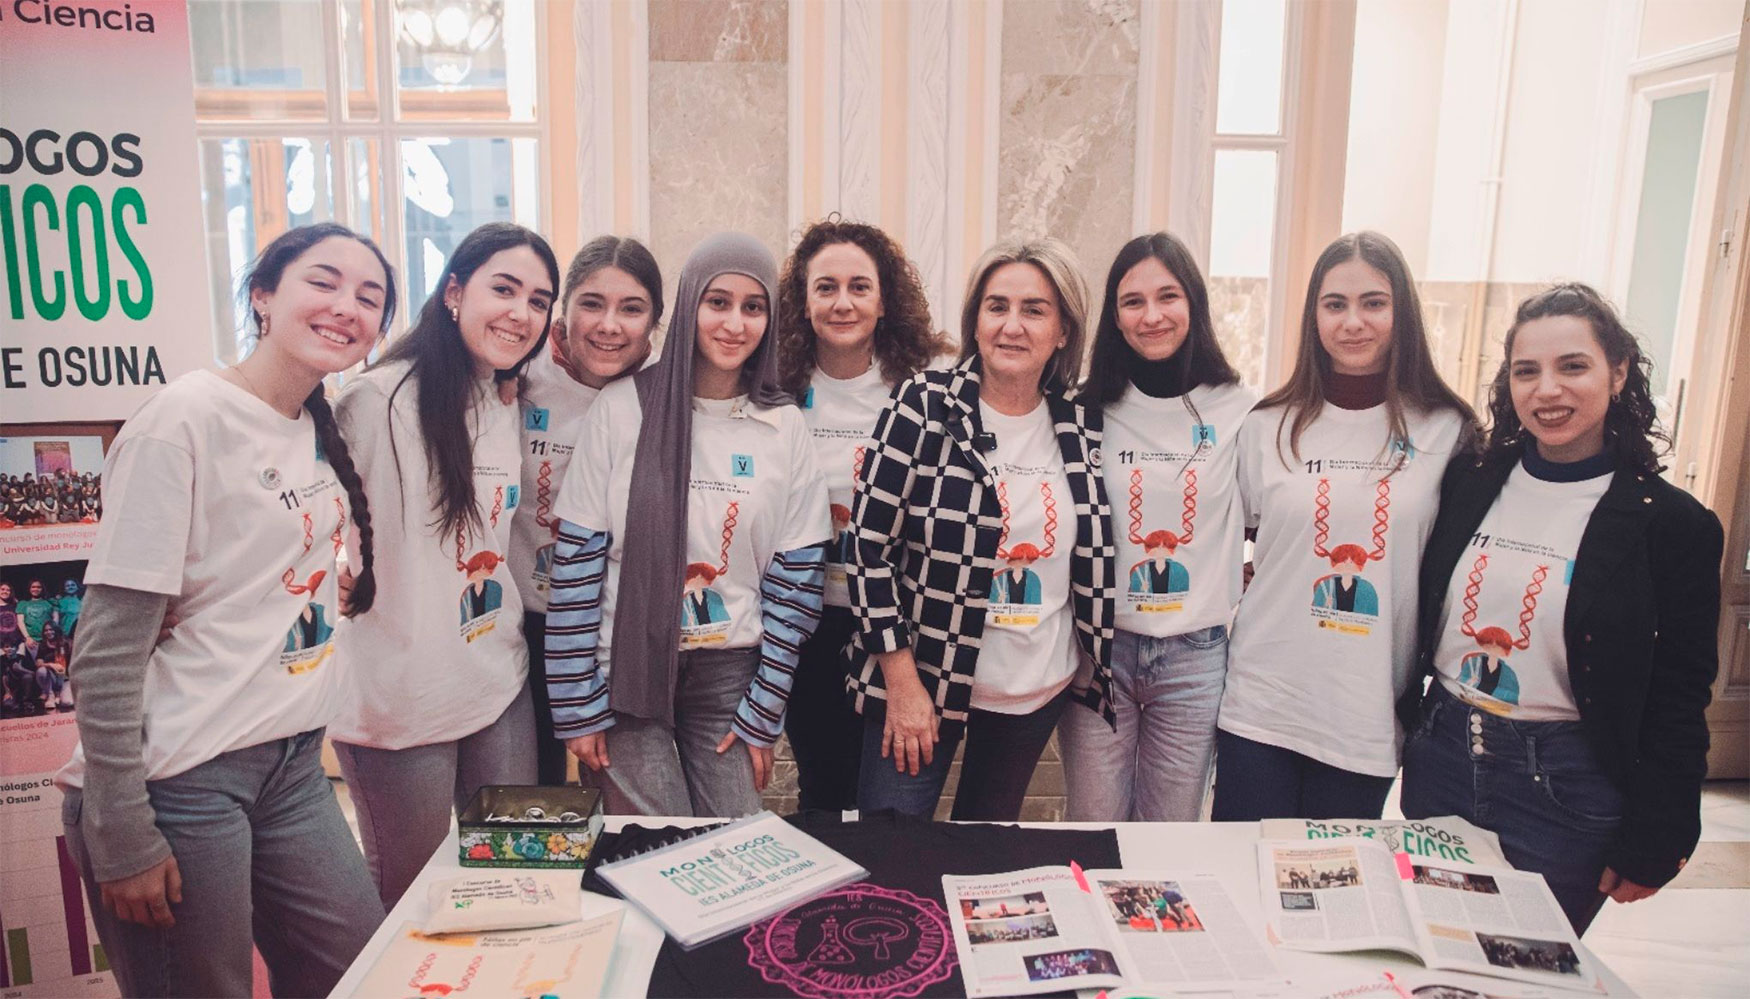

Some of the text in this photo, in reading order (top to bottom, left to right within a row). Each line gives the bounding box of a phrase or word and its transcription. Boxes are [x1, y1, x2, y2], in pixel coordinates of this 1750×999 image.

[14, 0, 155, 33] Ciencia
[0, 183, 154, 321] ICOS
[38, 346, 166, 388] OSUNA
[530, 440, 546, 455] 11
[1118, 450, 1134, 464] 11
[1305, 459, 1321, 474] 11
[279, 489, 300, 510] 11
[3, 543, 60, 554] Universidad
[63, 542, 79, 551] Rey
[1472, 532, 1490, 548] 11
[37, 720, 49, 728] de
[27, 732, 49, 741] 2024
[7, 795, 40, 804] Osuna
[659, 834, 775, 878] MON LOGOS
[670, 863, 737, 896] CIENT
[737, 841, 802, 873] FICOS
[700, 895, 720, 906] IES
[720, 878, 768, 903] ALAMEDA
[769, 871, 782, 883] DE
[782, 858, 816, 878] OSUNA
